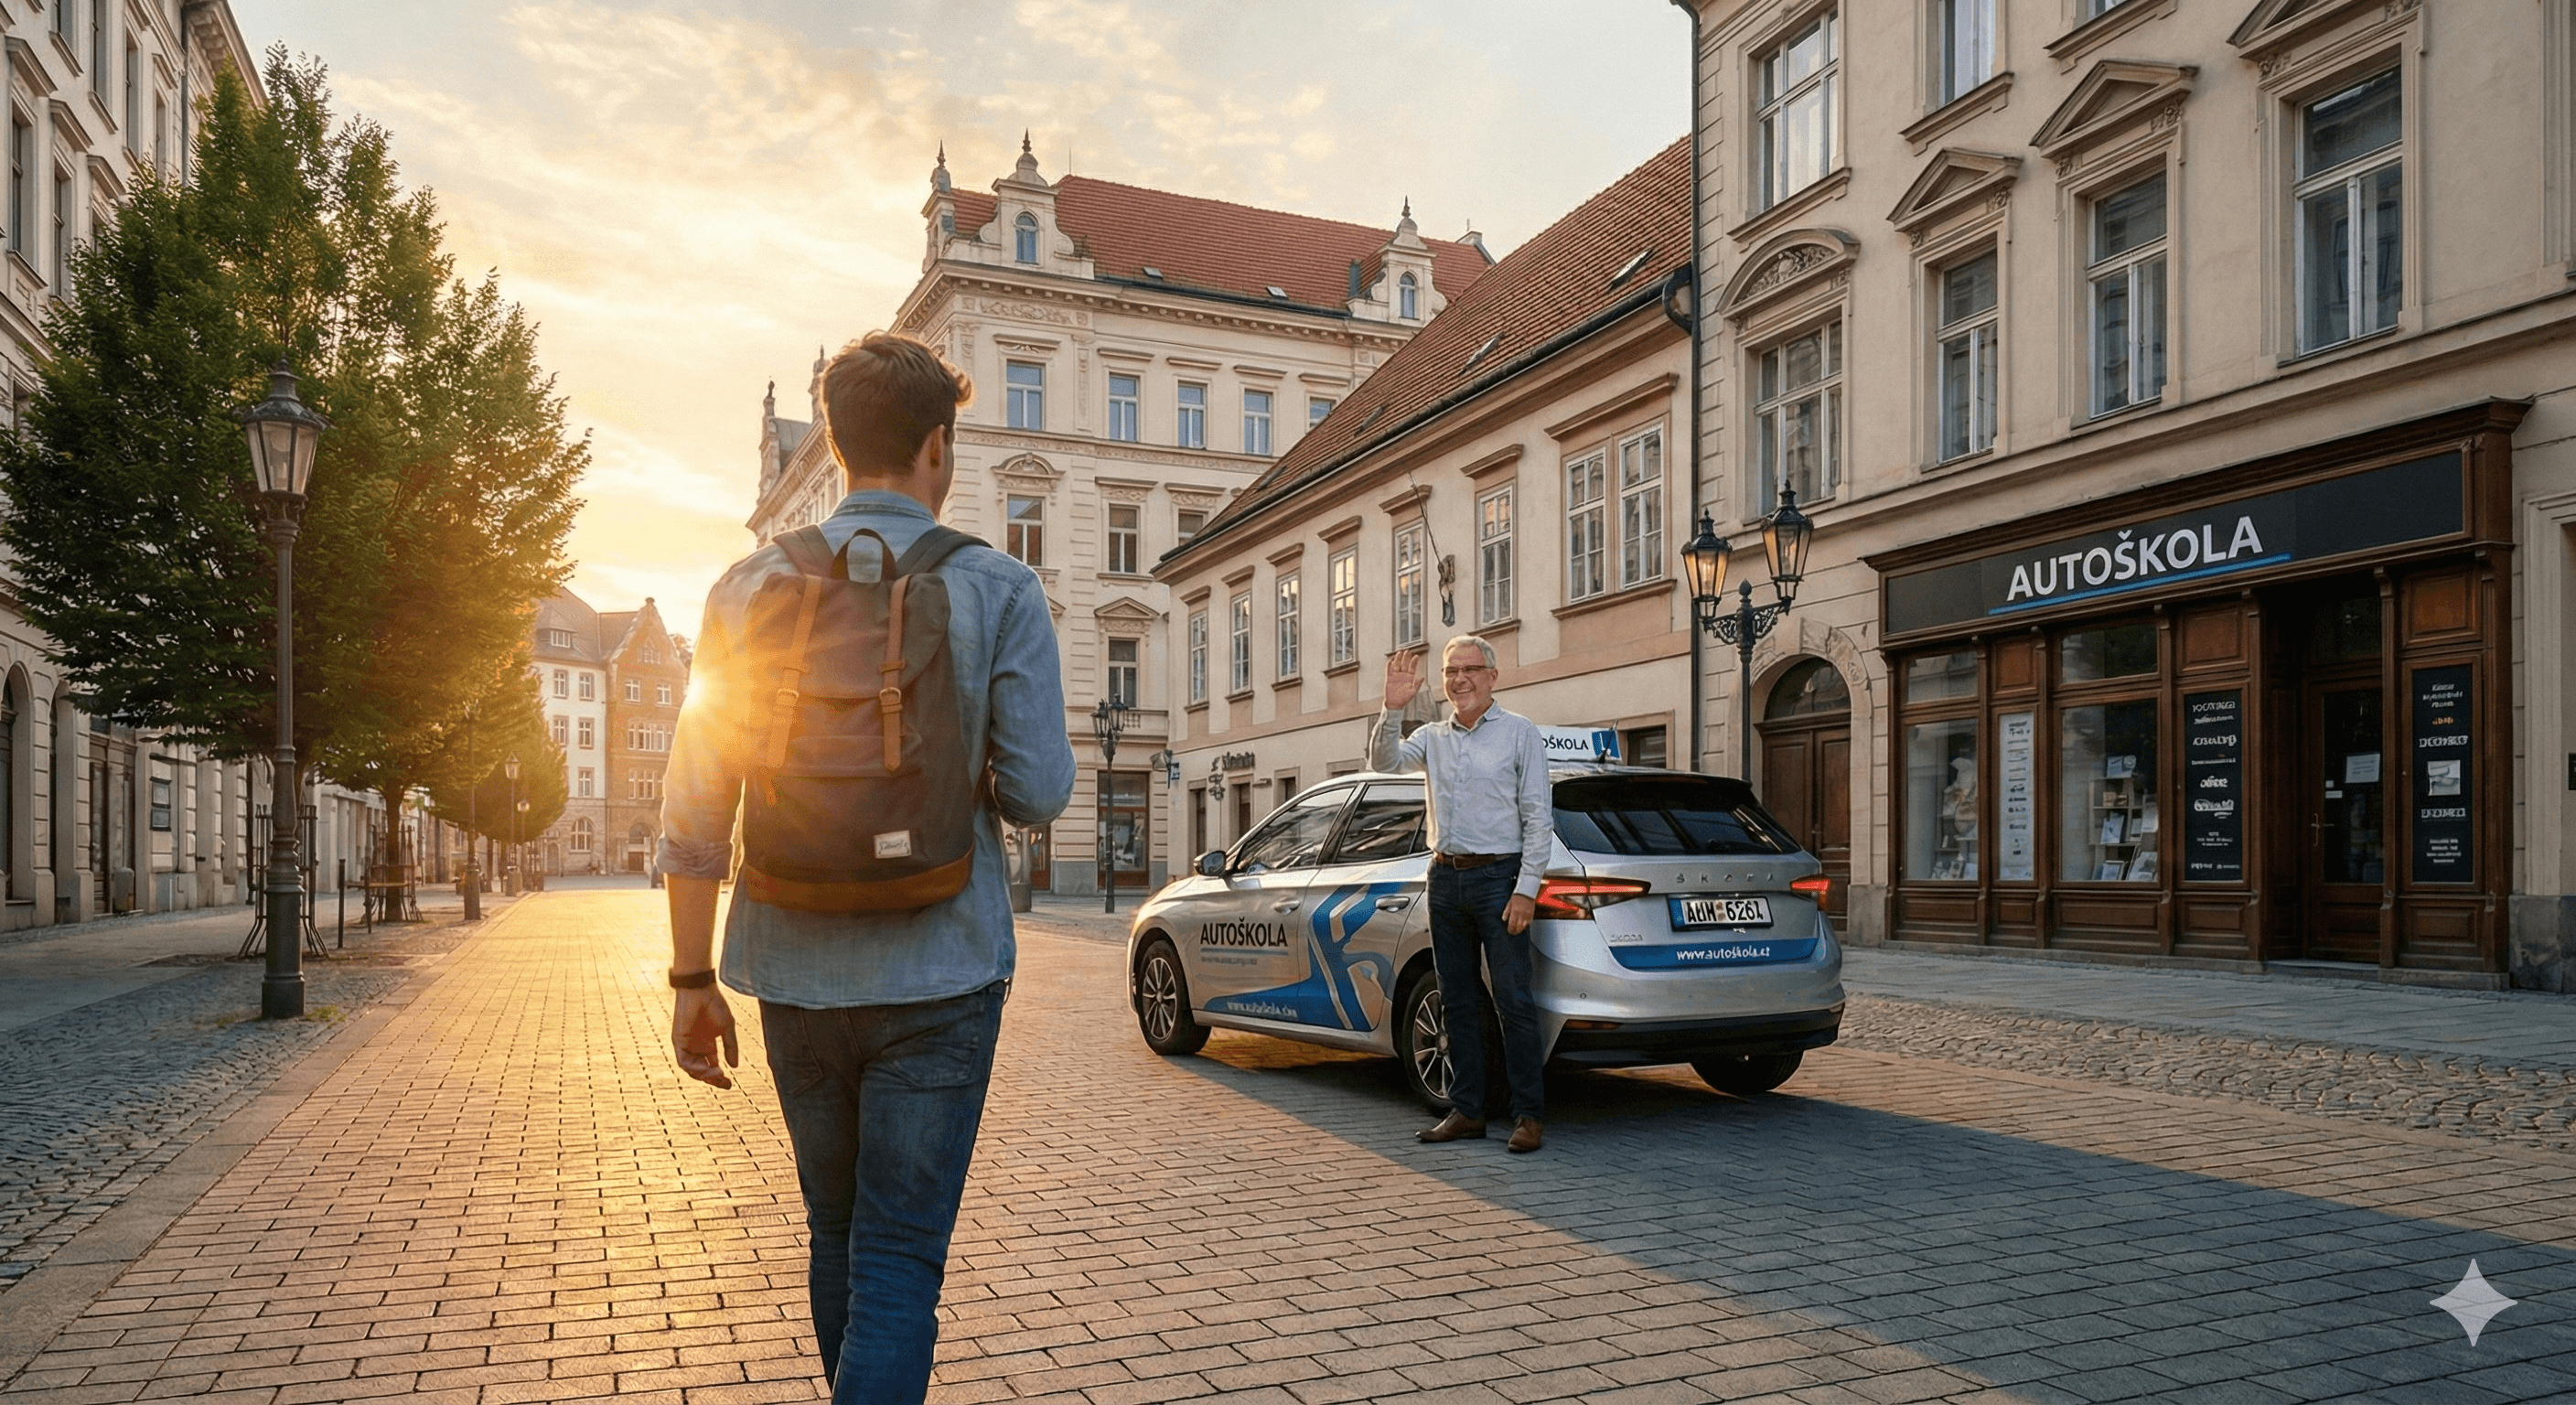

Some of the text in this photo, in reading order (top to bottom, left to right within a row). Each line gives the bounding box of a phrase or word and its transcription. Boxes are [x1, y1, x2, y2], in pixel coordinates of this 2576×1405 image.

[2006, 515, 2263, 602] AUTOŠKOLA
[1541, 735, 1589, 750] OŠKOLA
[1199, 917, 1289, 947] AUTOŠKOLA
